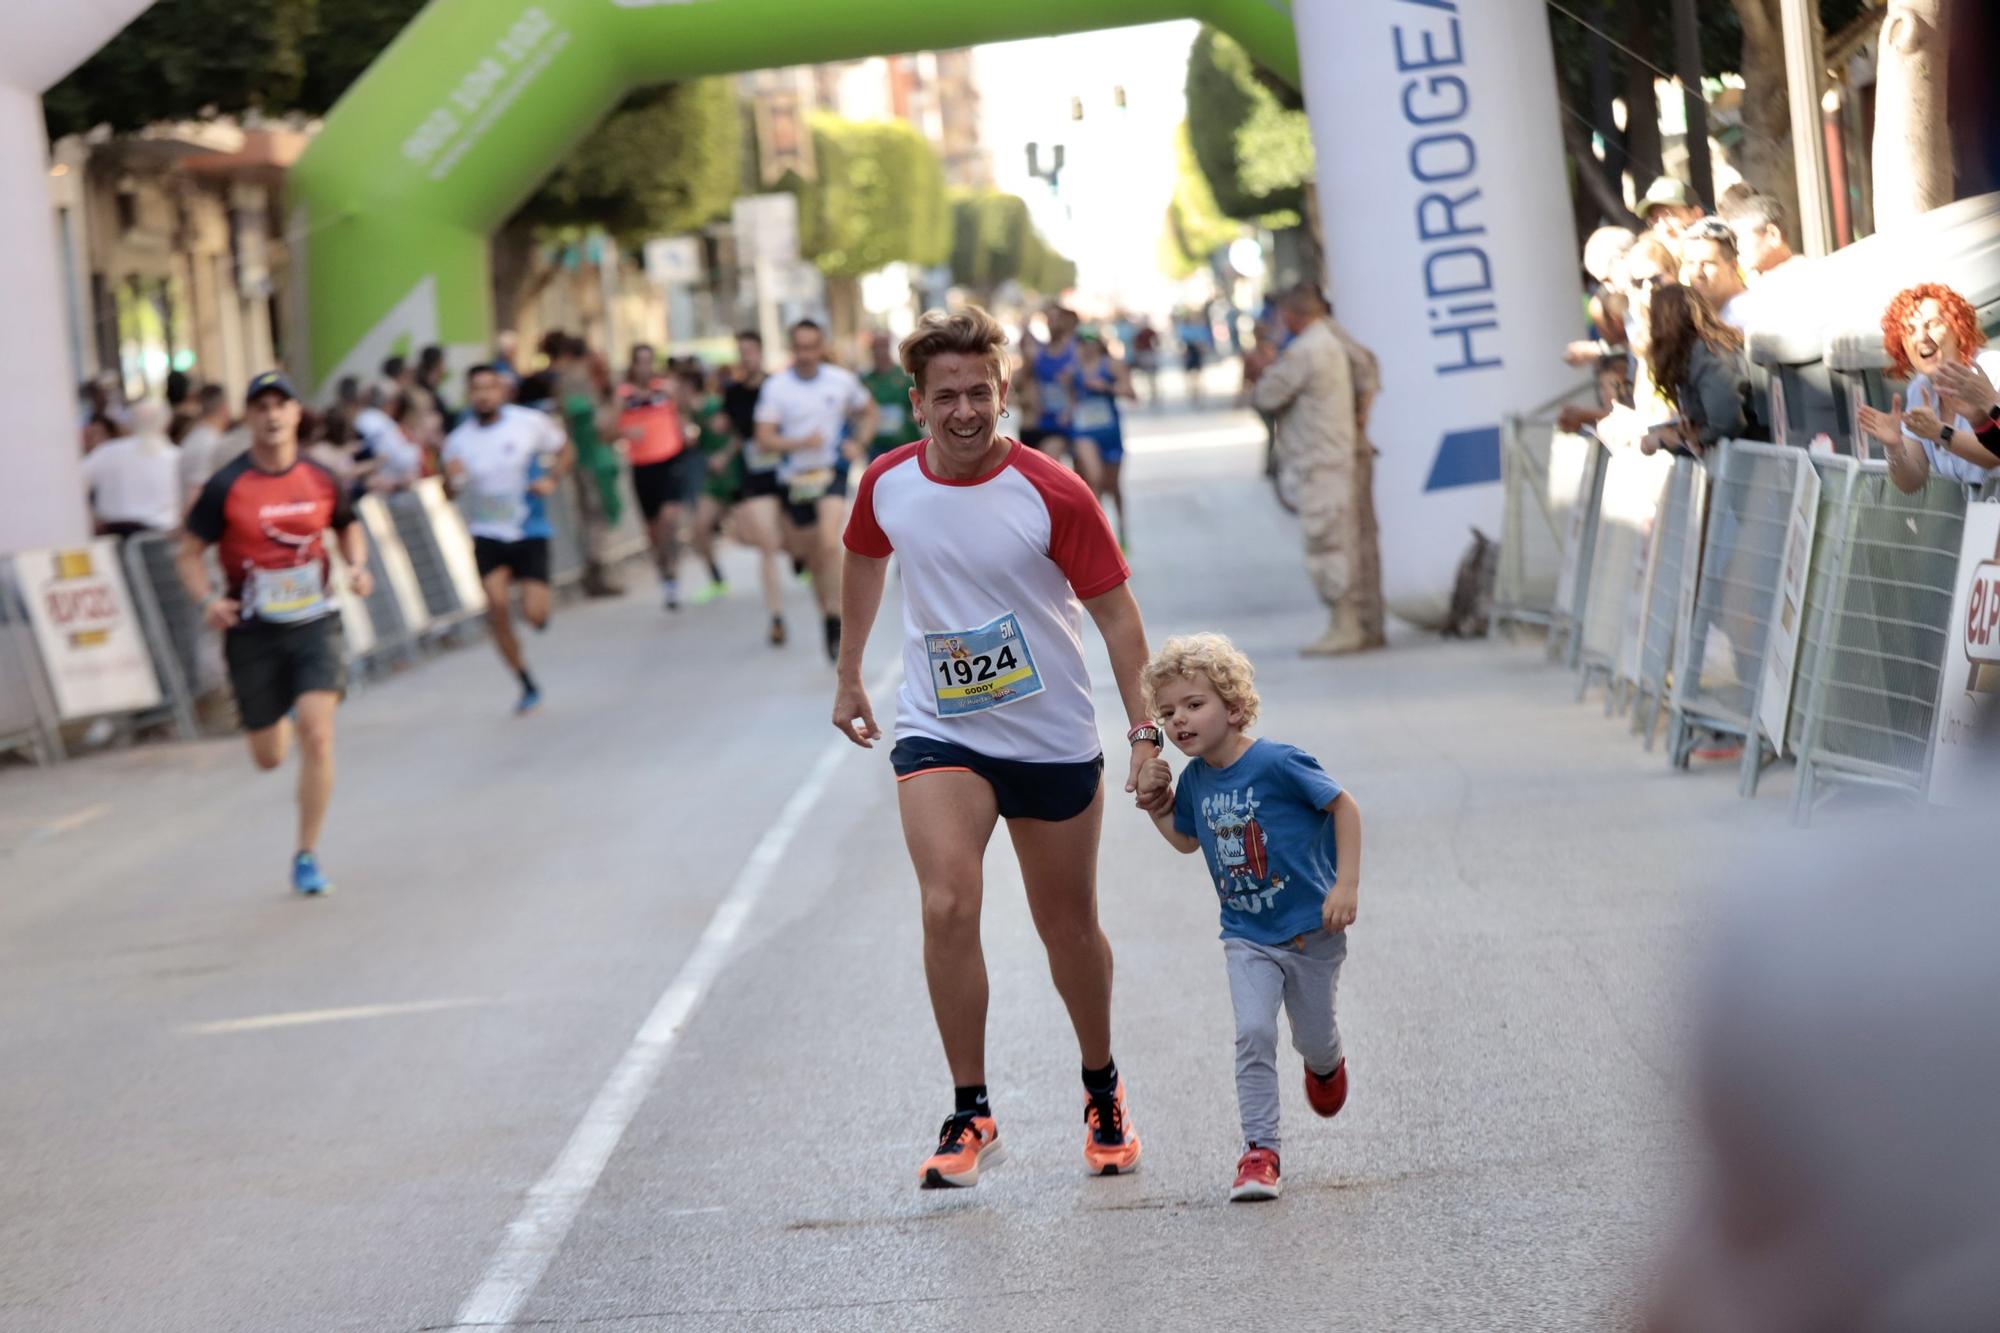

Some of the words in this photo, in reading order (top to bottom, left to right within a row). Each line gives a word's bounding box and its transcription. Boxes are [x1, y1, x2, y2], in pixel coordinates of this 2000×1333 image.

[1392, 0, 1504, 376] HiDROGE
[1000, 619, 1015, 641] 5K
[939, 645, 1017, 686] 1924
[965, 682, 994, 695] GODOY
[1202, 786, 1261, 816] CHILL
[1227, 887, 1281, 914] OUT
